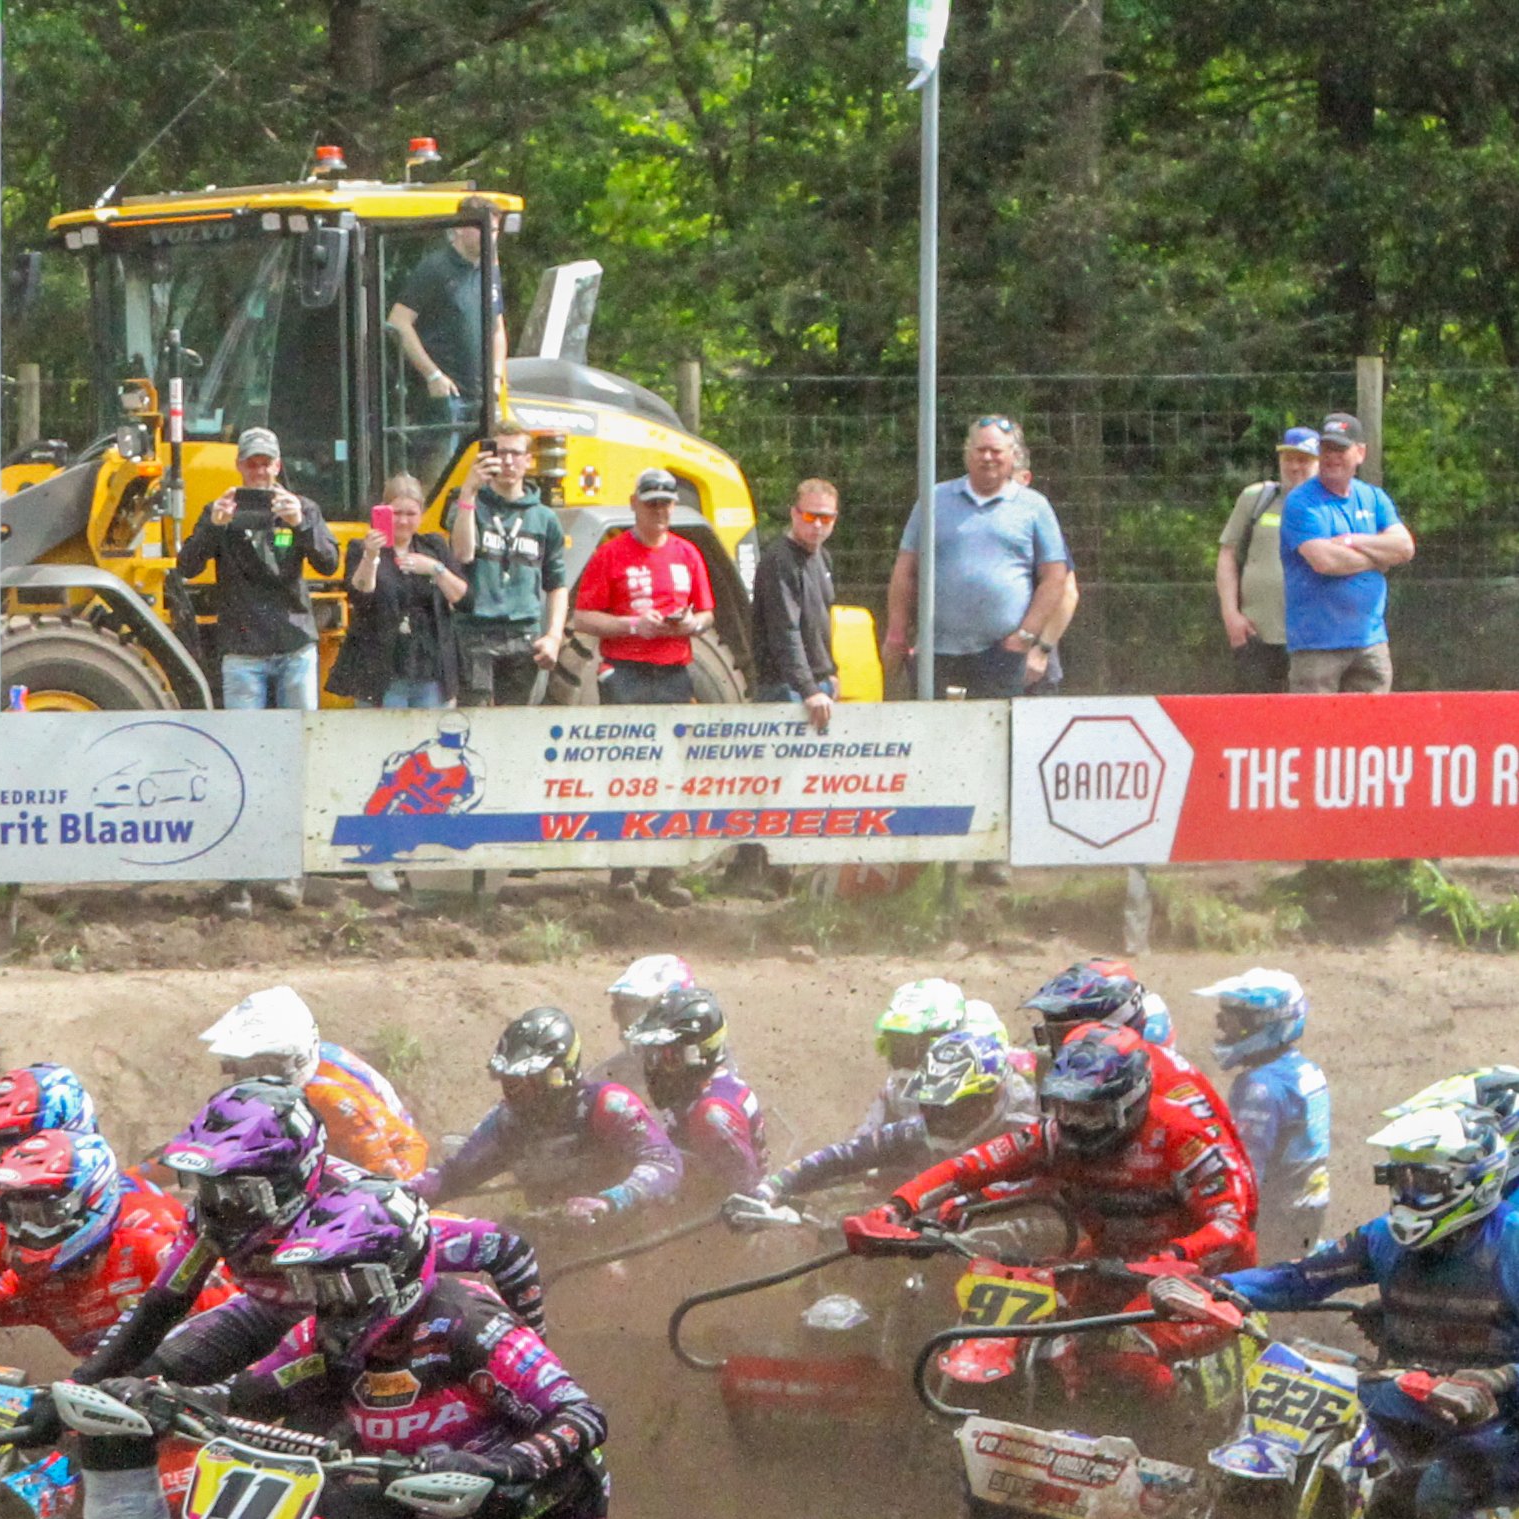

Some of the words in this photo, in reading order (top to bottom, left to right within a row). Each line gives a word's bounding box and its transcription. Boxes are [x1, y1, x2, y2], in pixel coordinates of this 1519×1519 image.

[568, 724, 657, 740] KLEDING
[691, 722, 810, 739] GEBRUIKTE
[562, 746, 663, 763] MOTOREN
[685, 744, 766, 760] NIEUWE
[773, 742, 912, 759] ONDERDELEN
[543, 778, 595, 800] TEL.
[607, 777, 660, 797] 038
[681, 775, 782, 796] 4211701
[802, 773, 907, 794] ZWOLLE
[1054, 761, 1149, 802] BANZO
[1223, 748, 1301, 811] THE
[1314, 745, 1414, 808] WAY
[1424, 743, 1477, 807] TO
[60, 812, 194, 845] Blaauw
[539, 813, 597, 842] W.
[621, 808, 895, 841] KALSBEEK
[961, 1283, 1049, 1327] 97
[1247, 1372, 1351, 1431] 226
